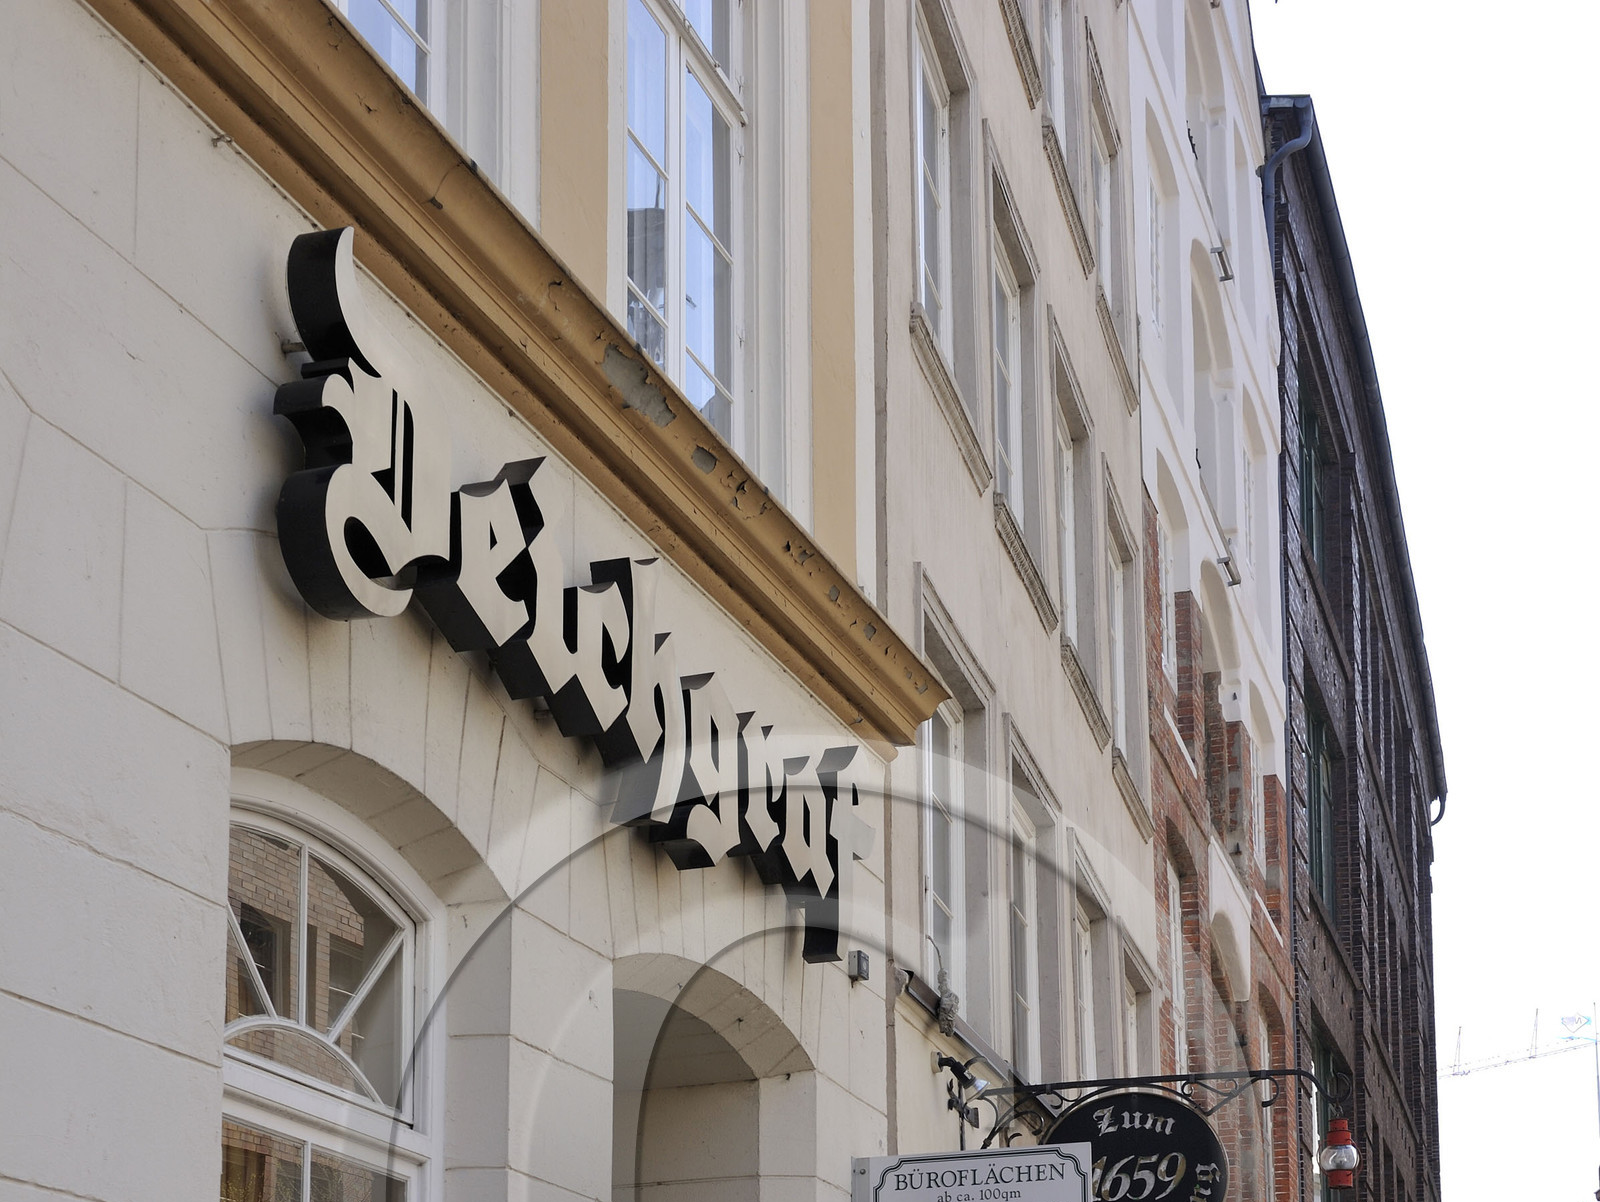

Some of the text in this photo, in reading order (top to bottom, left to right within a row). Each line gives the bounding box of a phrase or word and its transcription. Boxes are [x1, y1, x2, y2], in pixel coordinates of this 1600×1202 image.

[273, 224, 878, 963] Deichgraf
[1092, 1105, 1176, 1137] Zum
[894, 1163, 1066, 1191] BÜROFLÄCHEN
[1092, 1152, 1187, 1201] 1659
[956, 1192, 975, 1202] ca.
[980, 1188, 1022, 1202] 100qm
